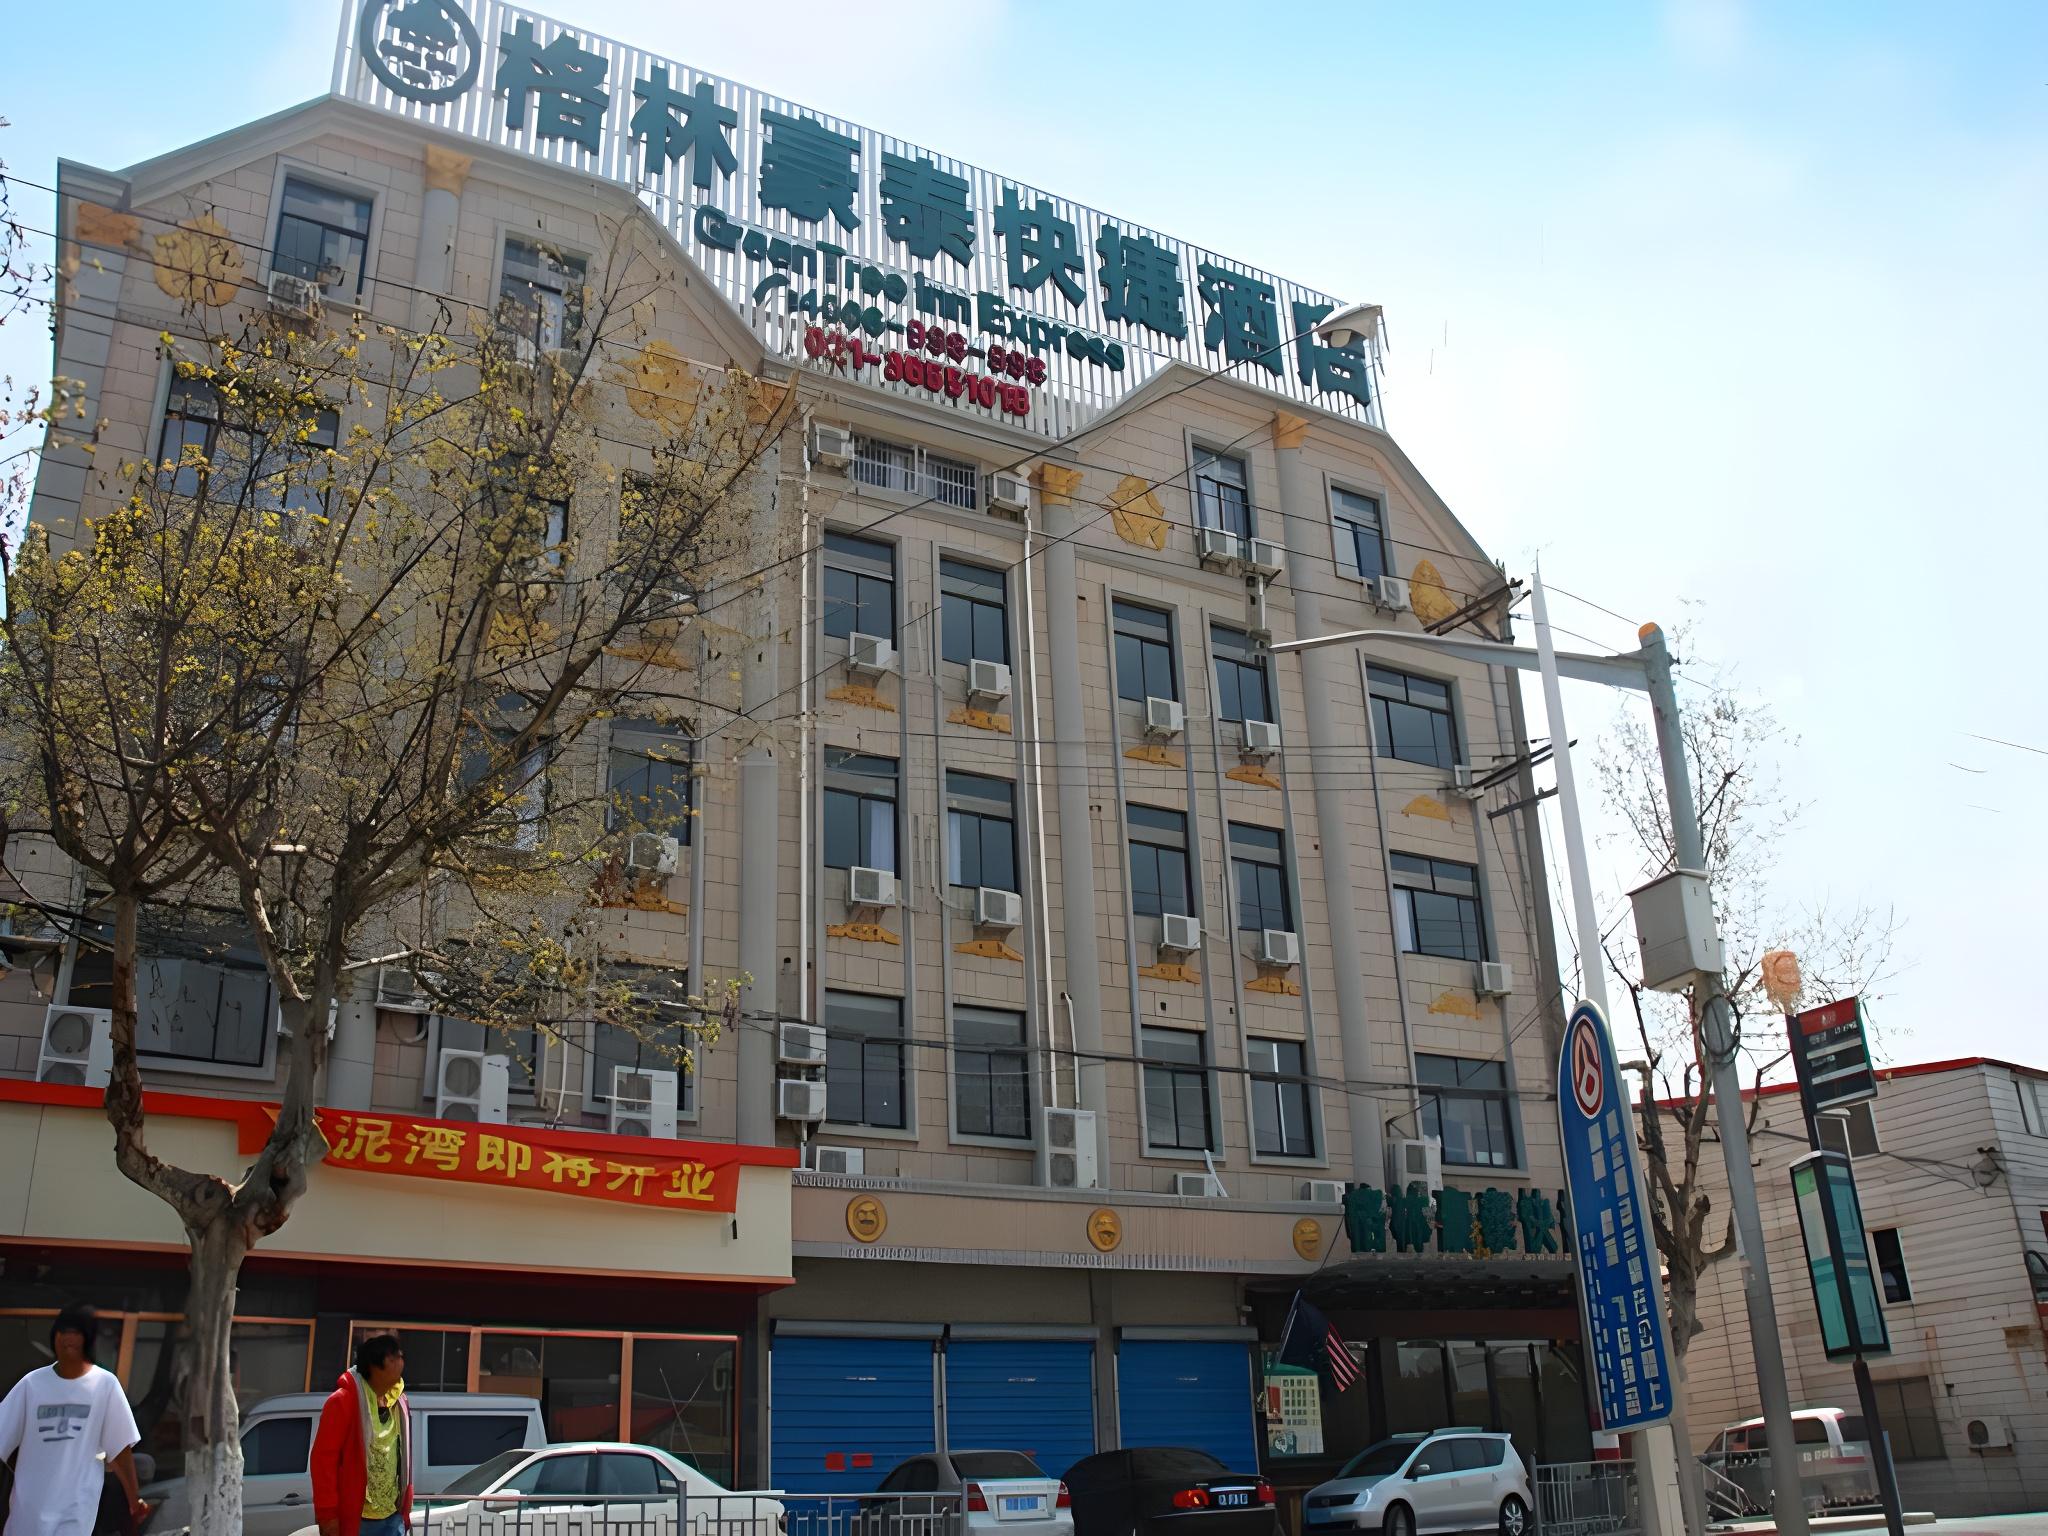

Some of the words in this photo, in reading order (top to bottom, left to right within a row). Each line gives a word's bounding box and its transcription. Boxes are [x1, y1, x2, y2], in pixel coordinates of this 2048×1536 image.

[496, 19, 1371, 407] 格林豪泰快捷酒店
